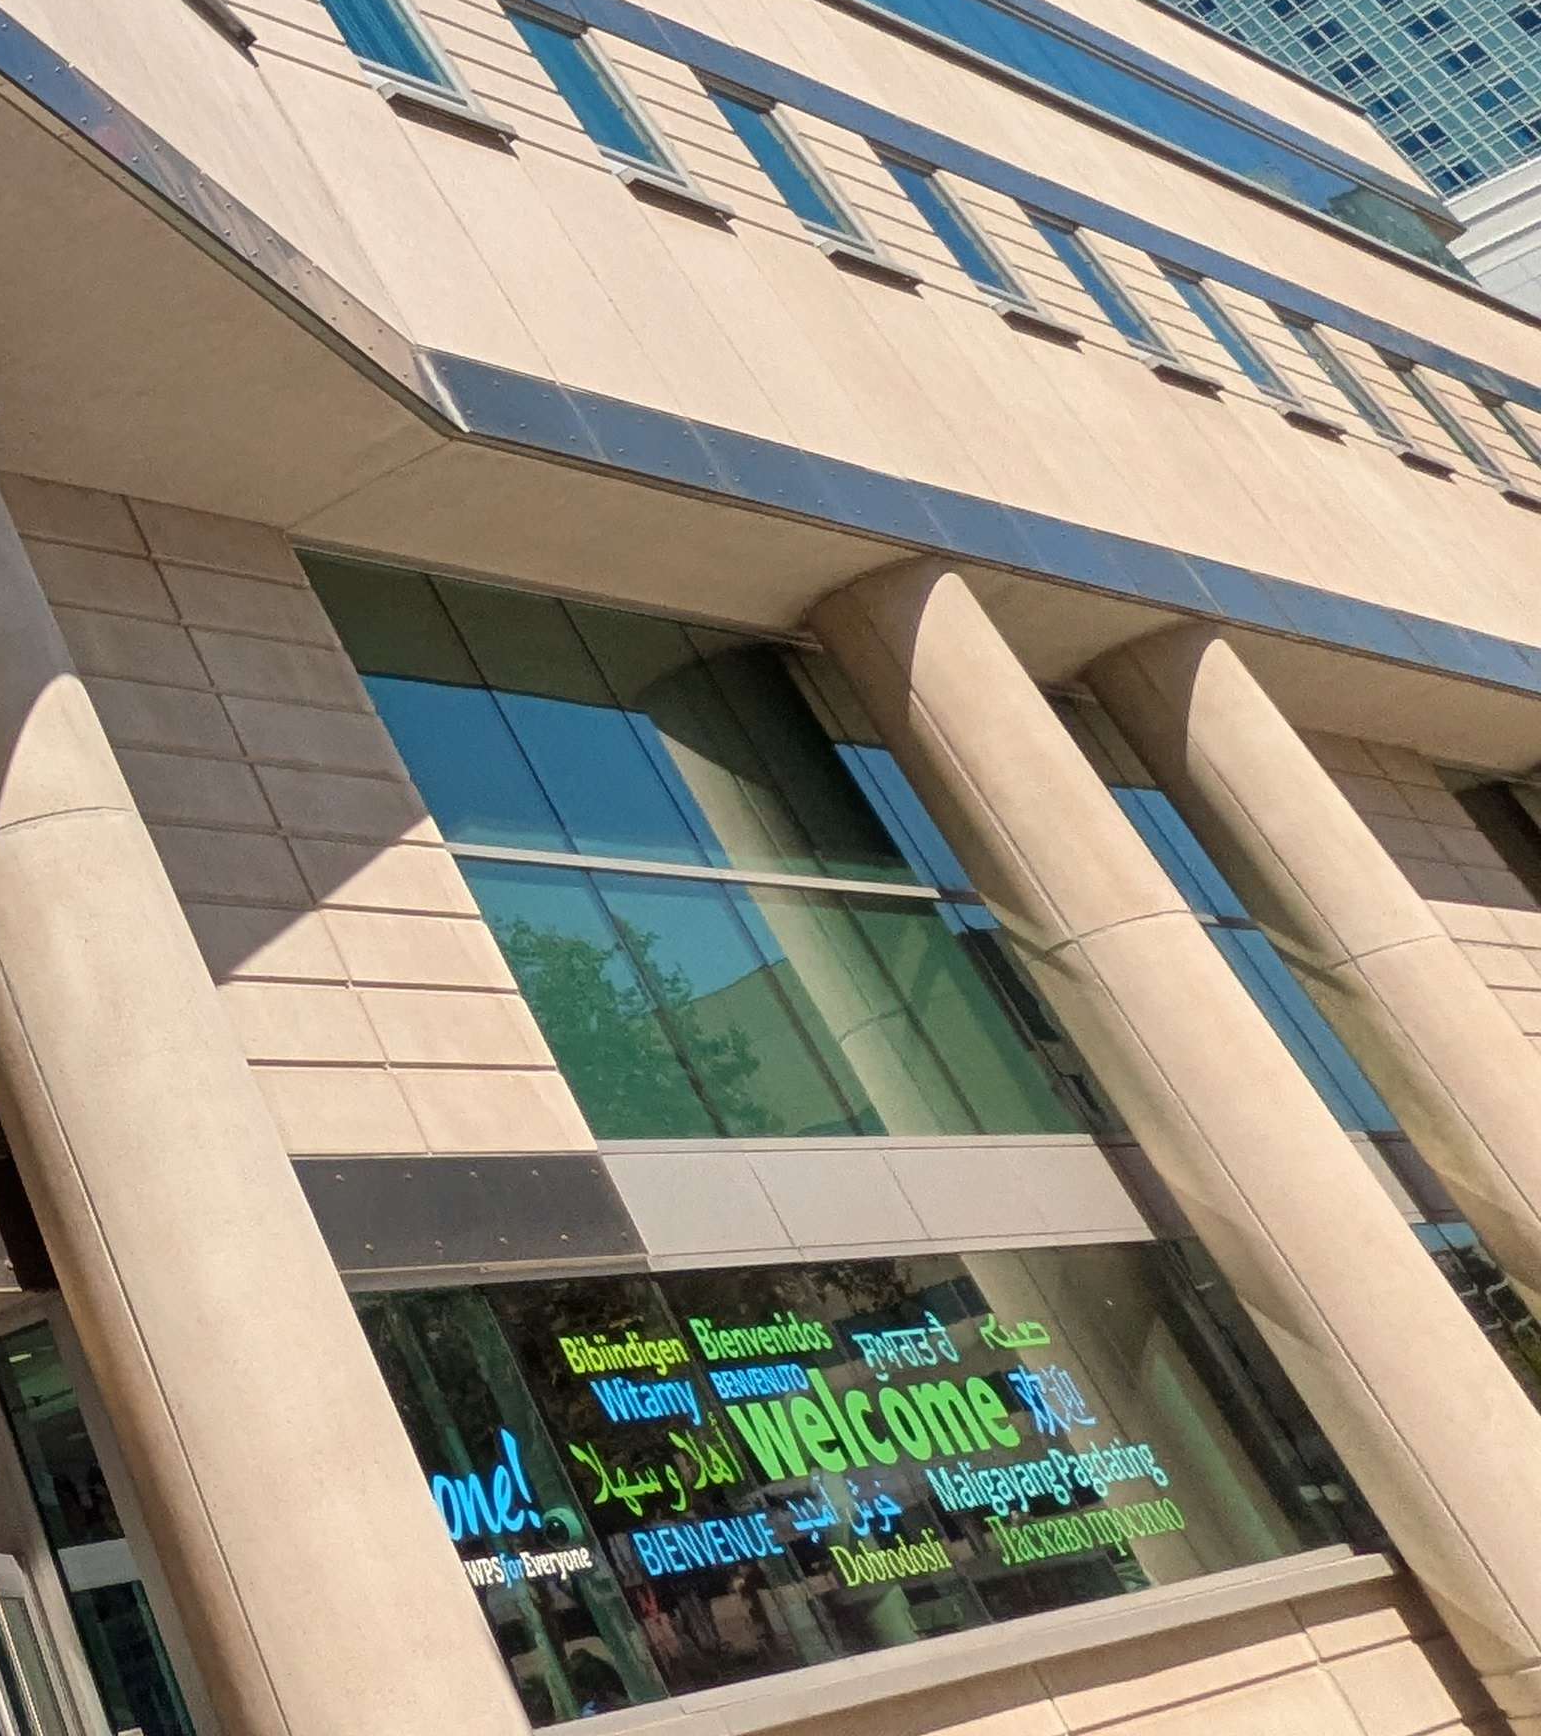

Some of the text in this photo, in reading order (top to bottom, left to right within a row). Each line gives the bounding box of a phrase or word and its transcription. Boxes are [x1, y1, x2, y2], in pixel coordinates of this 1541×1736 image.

[689, 1311, 833, 1361] Bienvenidos
[590, 1376, 702, 1426] Witamy
[709, 1363, 809, 1399] BENVENUTO
[1007, 1364, 1097, 1437] 欢迎
[724, 1368, 1021, 1481] welcome
[632, 1513, 785, 1577] BIENVENUE
[984, 1497, 1186, 1565] Ласкаво просимо
